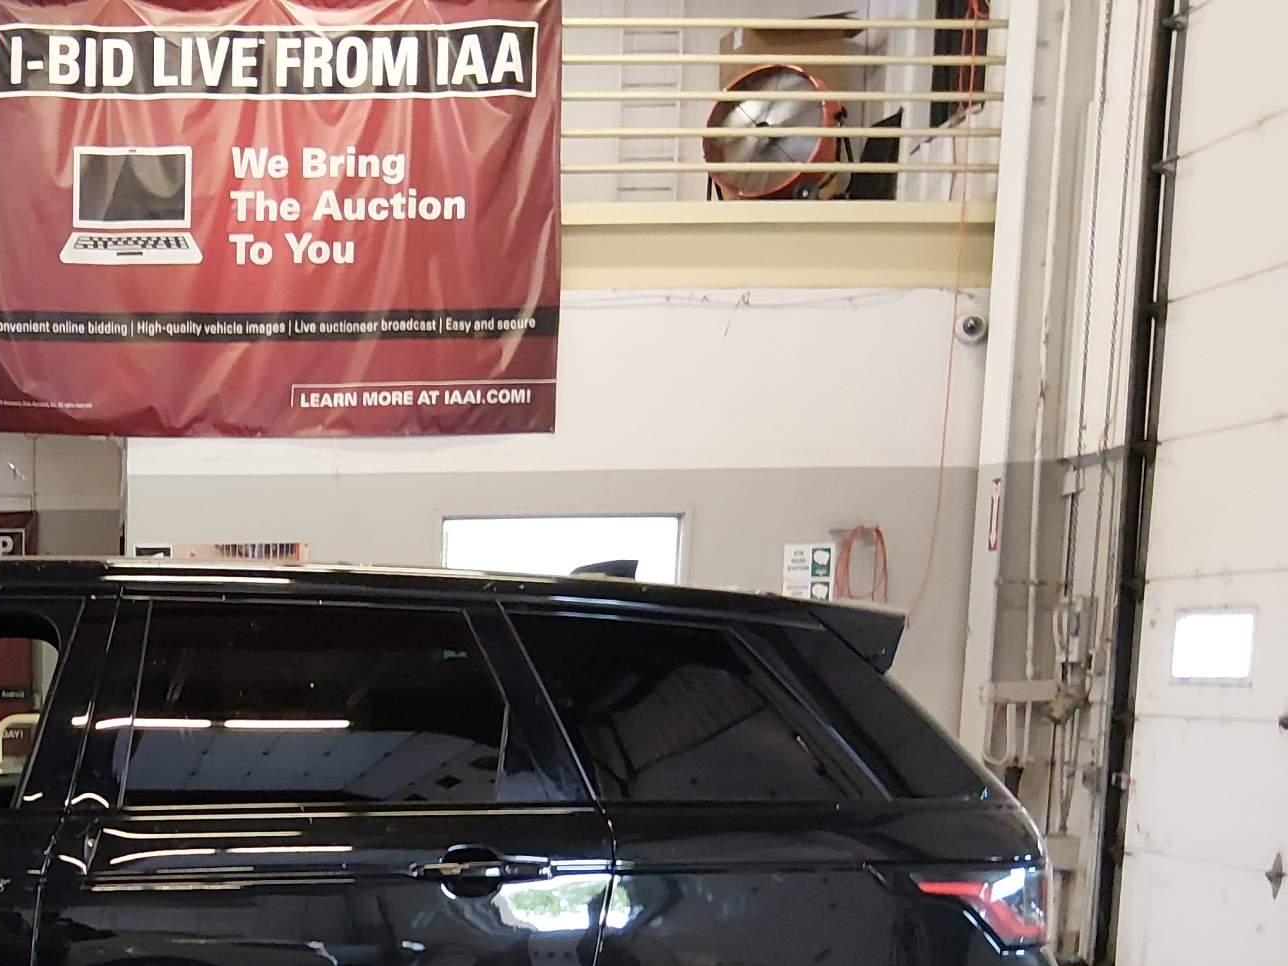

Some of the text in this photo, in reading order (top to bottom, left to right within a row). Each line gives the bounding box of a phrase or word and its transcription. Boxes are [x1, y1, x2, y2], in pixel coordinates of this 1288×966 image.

[10, 31, 525, 88] I-BID LIVE FROM IAA
[231, 146, 406, 185] We Bring
[229, 188, 466, 222] The Auction
[228, 232, 355, 265] To You
[52, 320, 85, 334] online
[88, 320, 128, 337] bidding
[137, 320, 202, 337] High-quality
[204, 320, 243, 335] vehicle
[245, 321, 285, 337] images
[294, 319, 316, 334] Live
[319, 320, 378, 334] auctioneer
[381, 317, 437, 332] broadcast
[445, 317, 472, 334] Easy
[474, 317, 495, 331] and
[497, 317, 536, 331] secure
[300, 388, 532, 408] LEARN MORE AT IAAI.COM!
